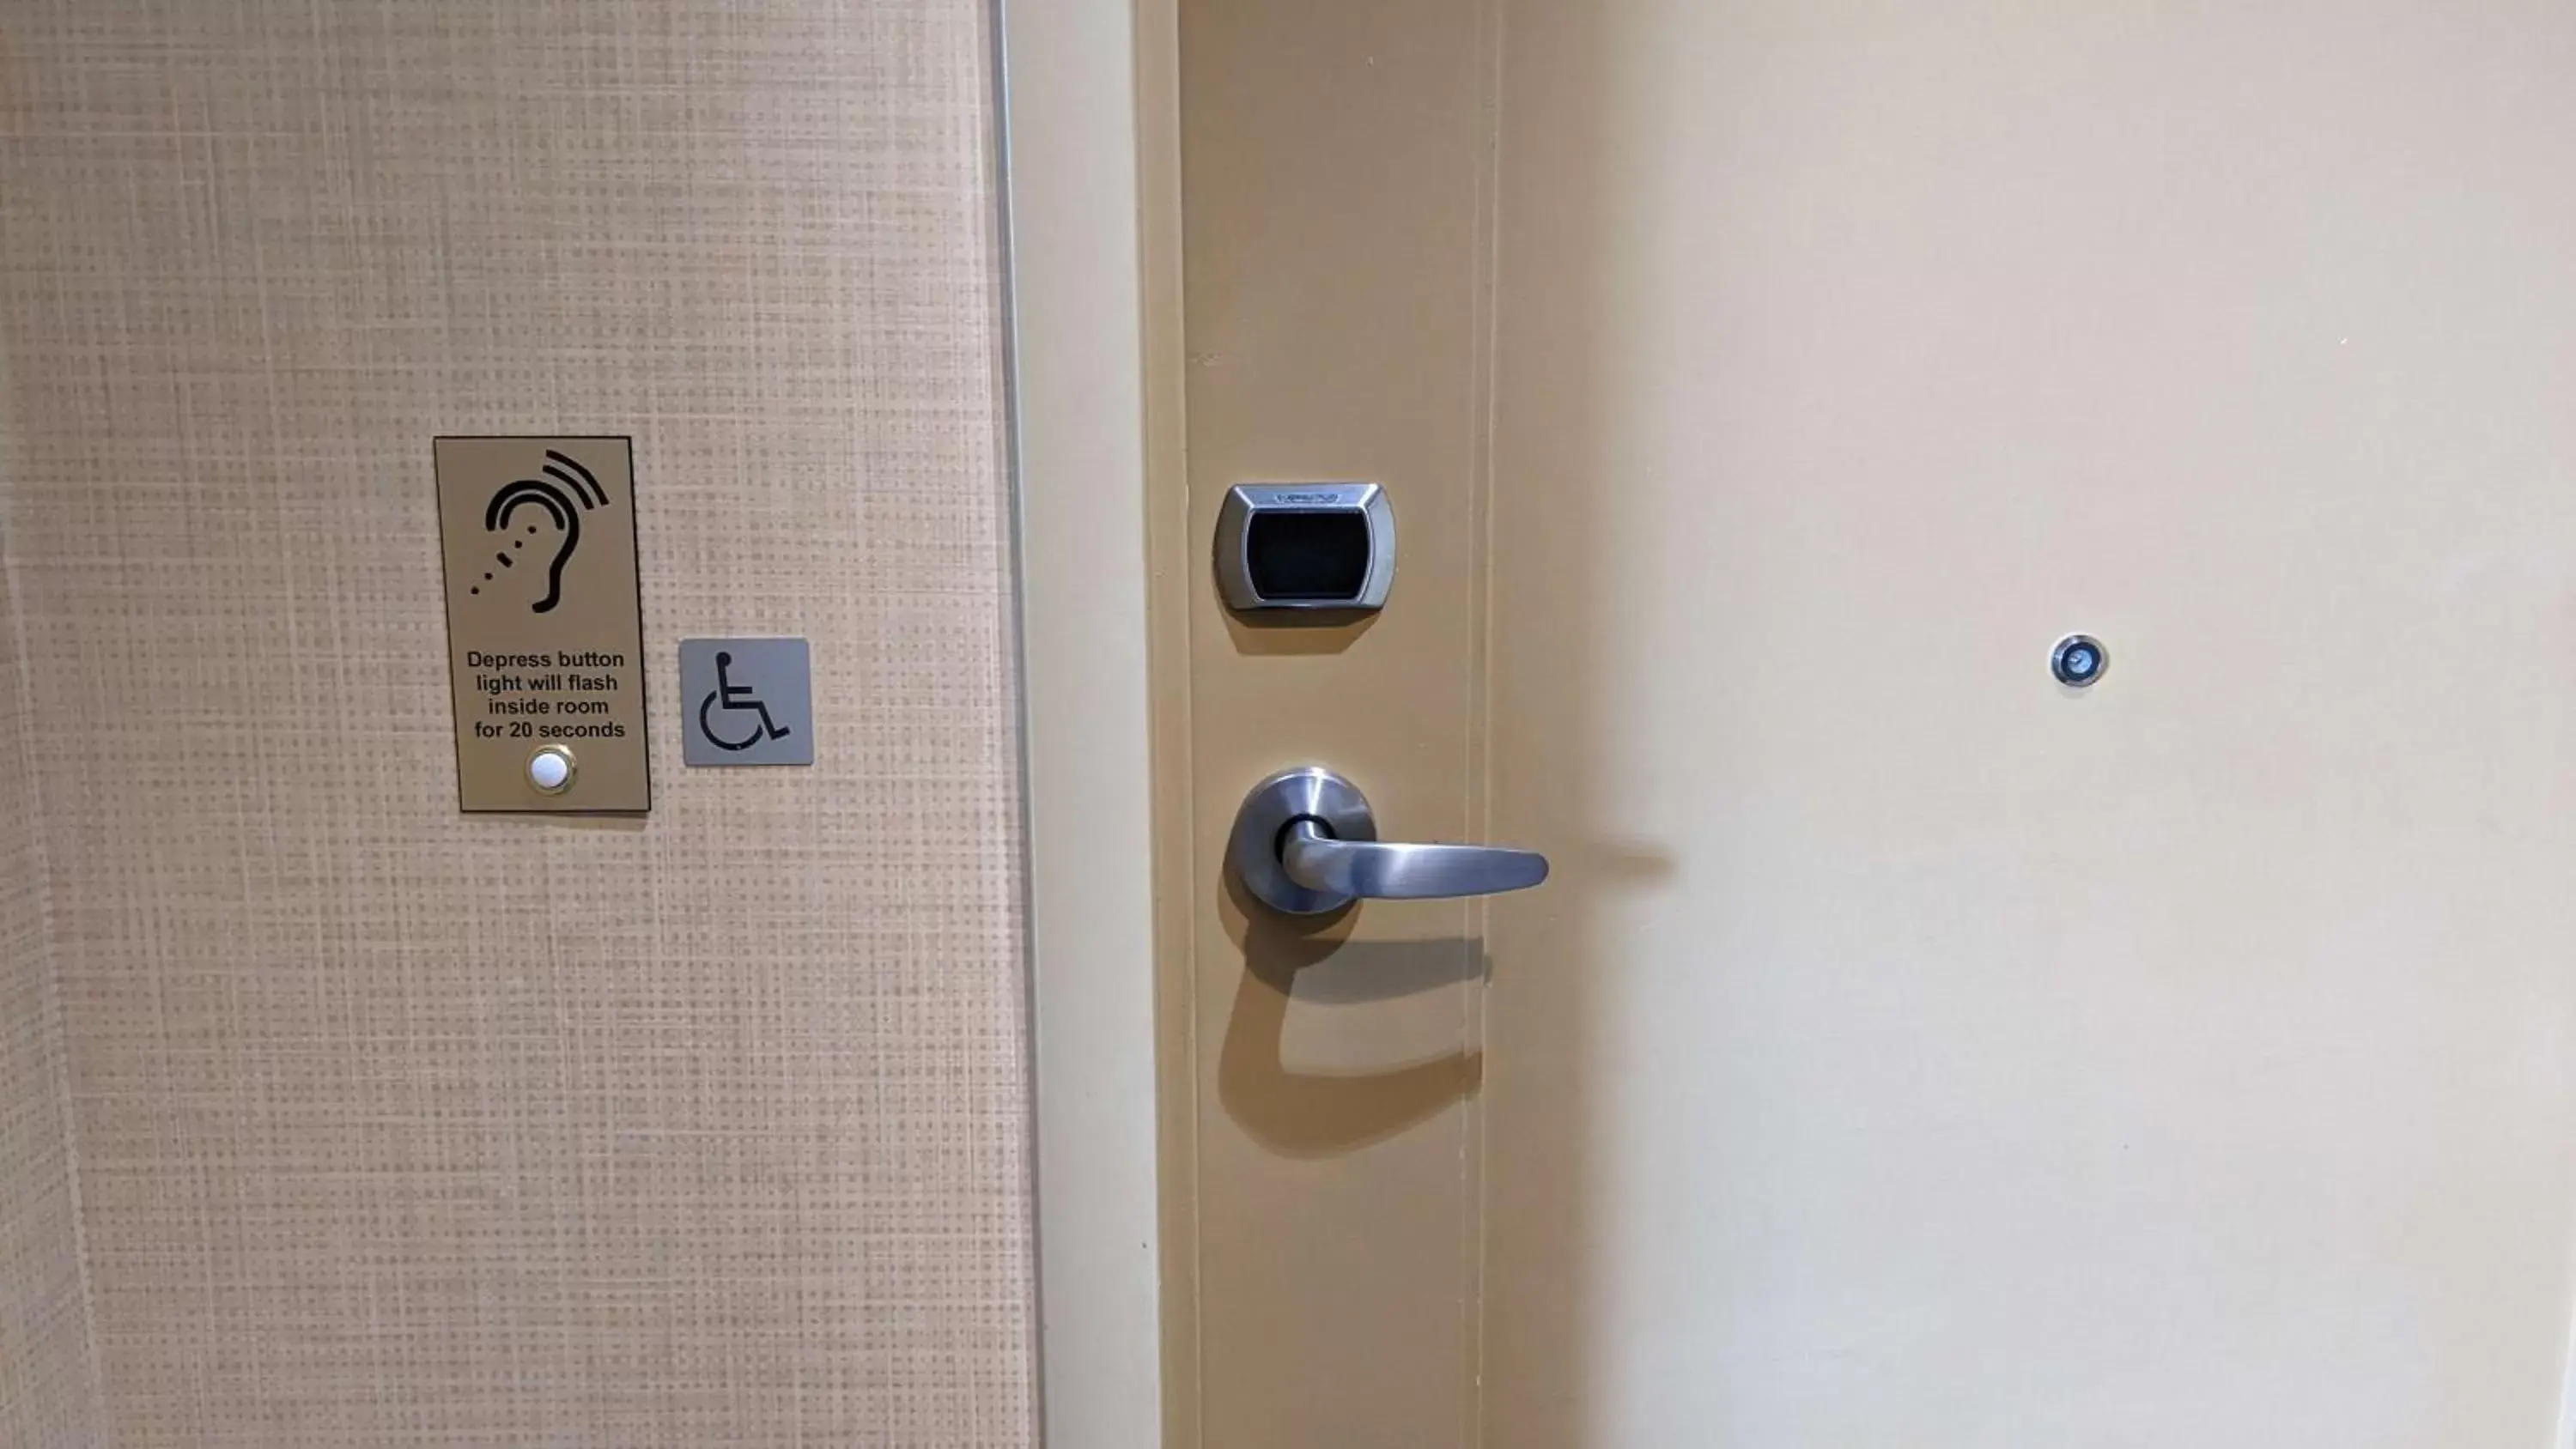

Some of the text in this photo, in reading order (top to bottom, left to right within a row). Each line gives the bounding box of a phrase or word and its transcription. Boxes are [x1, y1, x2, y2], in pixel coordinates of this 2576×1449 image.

[467, 651, 624, 670] Depress button
[477, 674, 617, 694] light will flash
[489, 698, 609, 714] inside room
[475, 721, 625, 738] for 20 seconds
